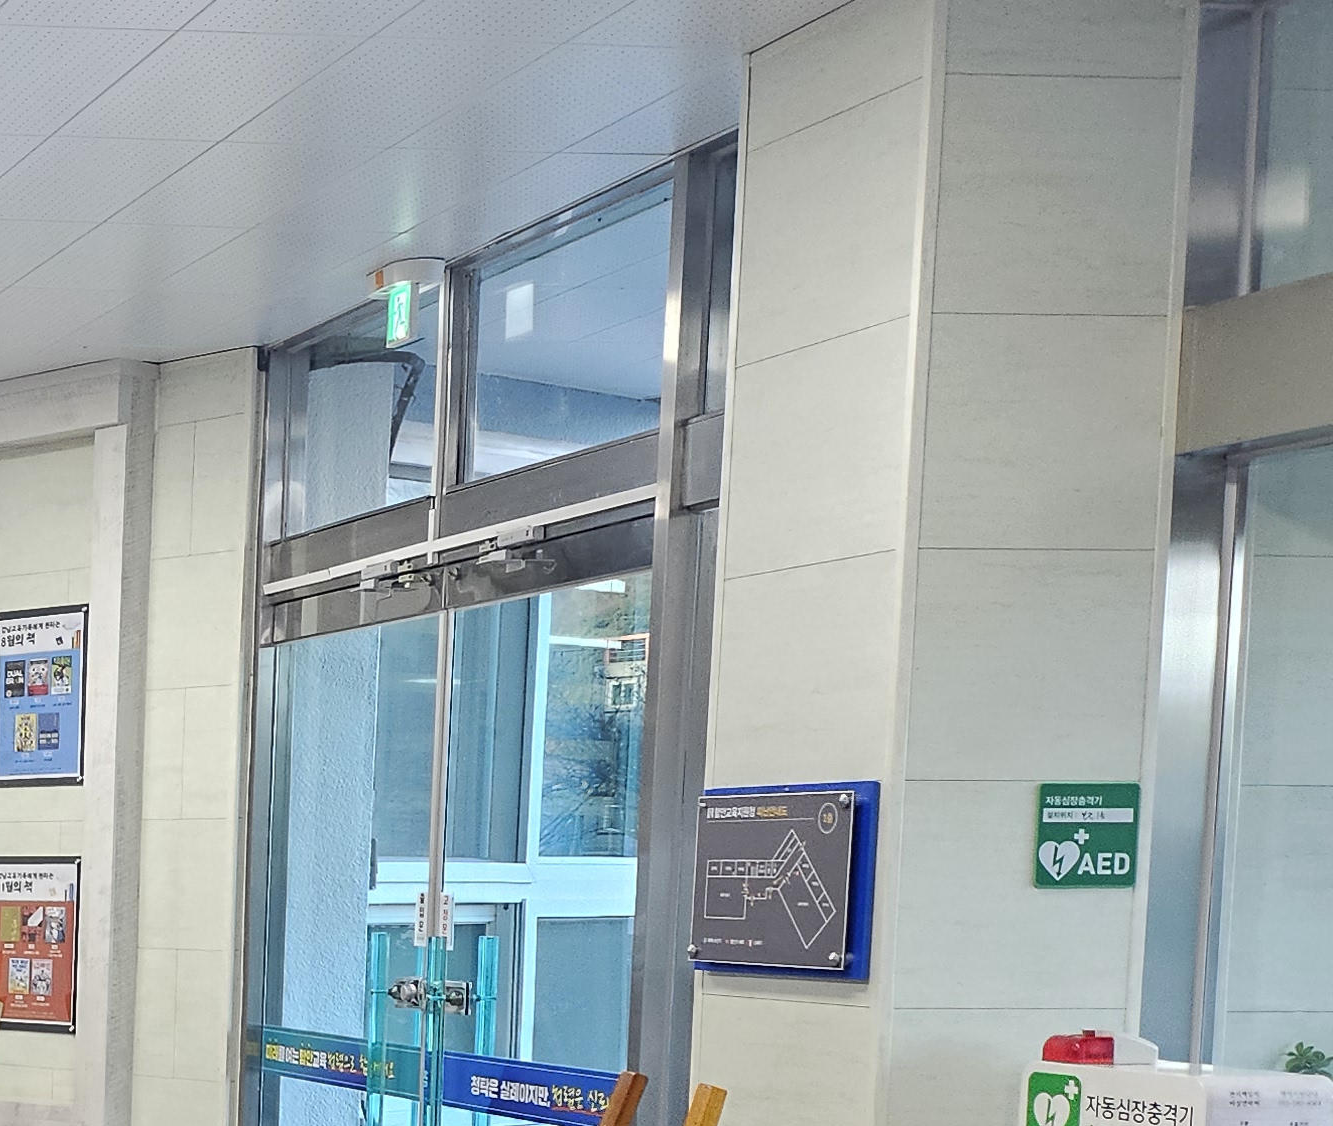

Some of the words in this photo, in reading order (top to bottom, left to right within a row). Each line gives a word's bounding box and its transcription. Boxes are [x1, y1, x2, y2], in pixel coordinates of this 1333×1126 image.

[1, 634, 24, 647] 8월의
[26, 633, 35, 644] 책
[1045, 796, 1102, 806] 자동심장충격기
[1077, 852, 1131, 875] AED
[24, 881, 32, 892] 책
[470, 1075, 498, 1098] 청탁은
[551, 1084, 583, 1111] 청렴은
